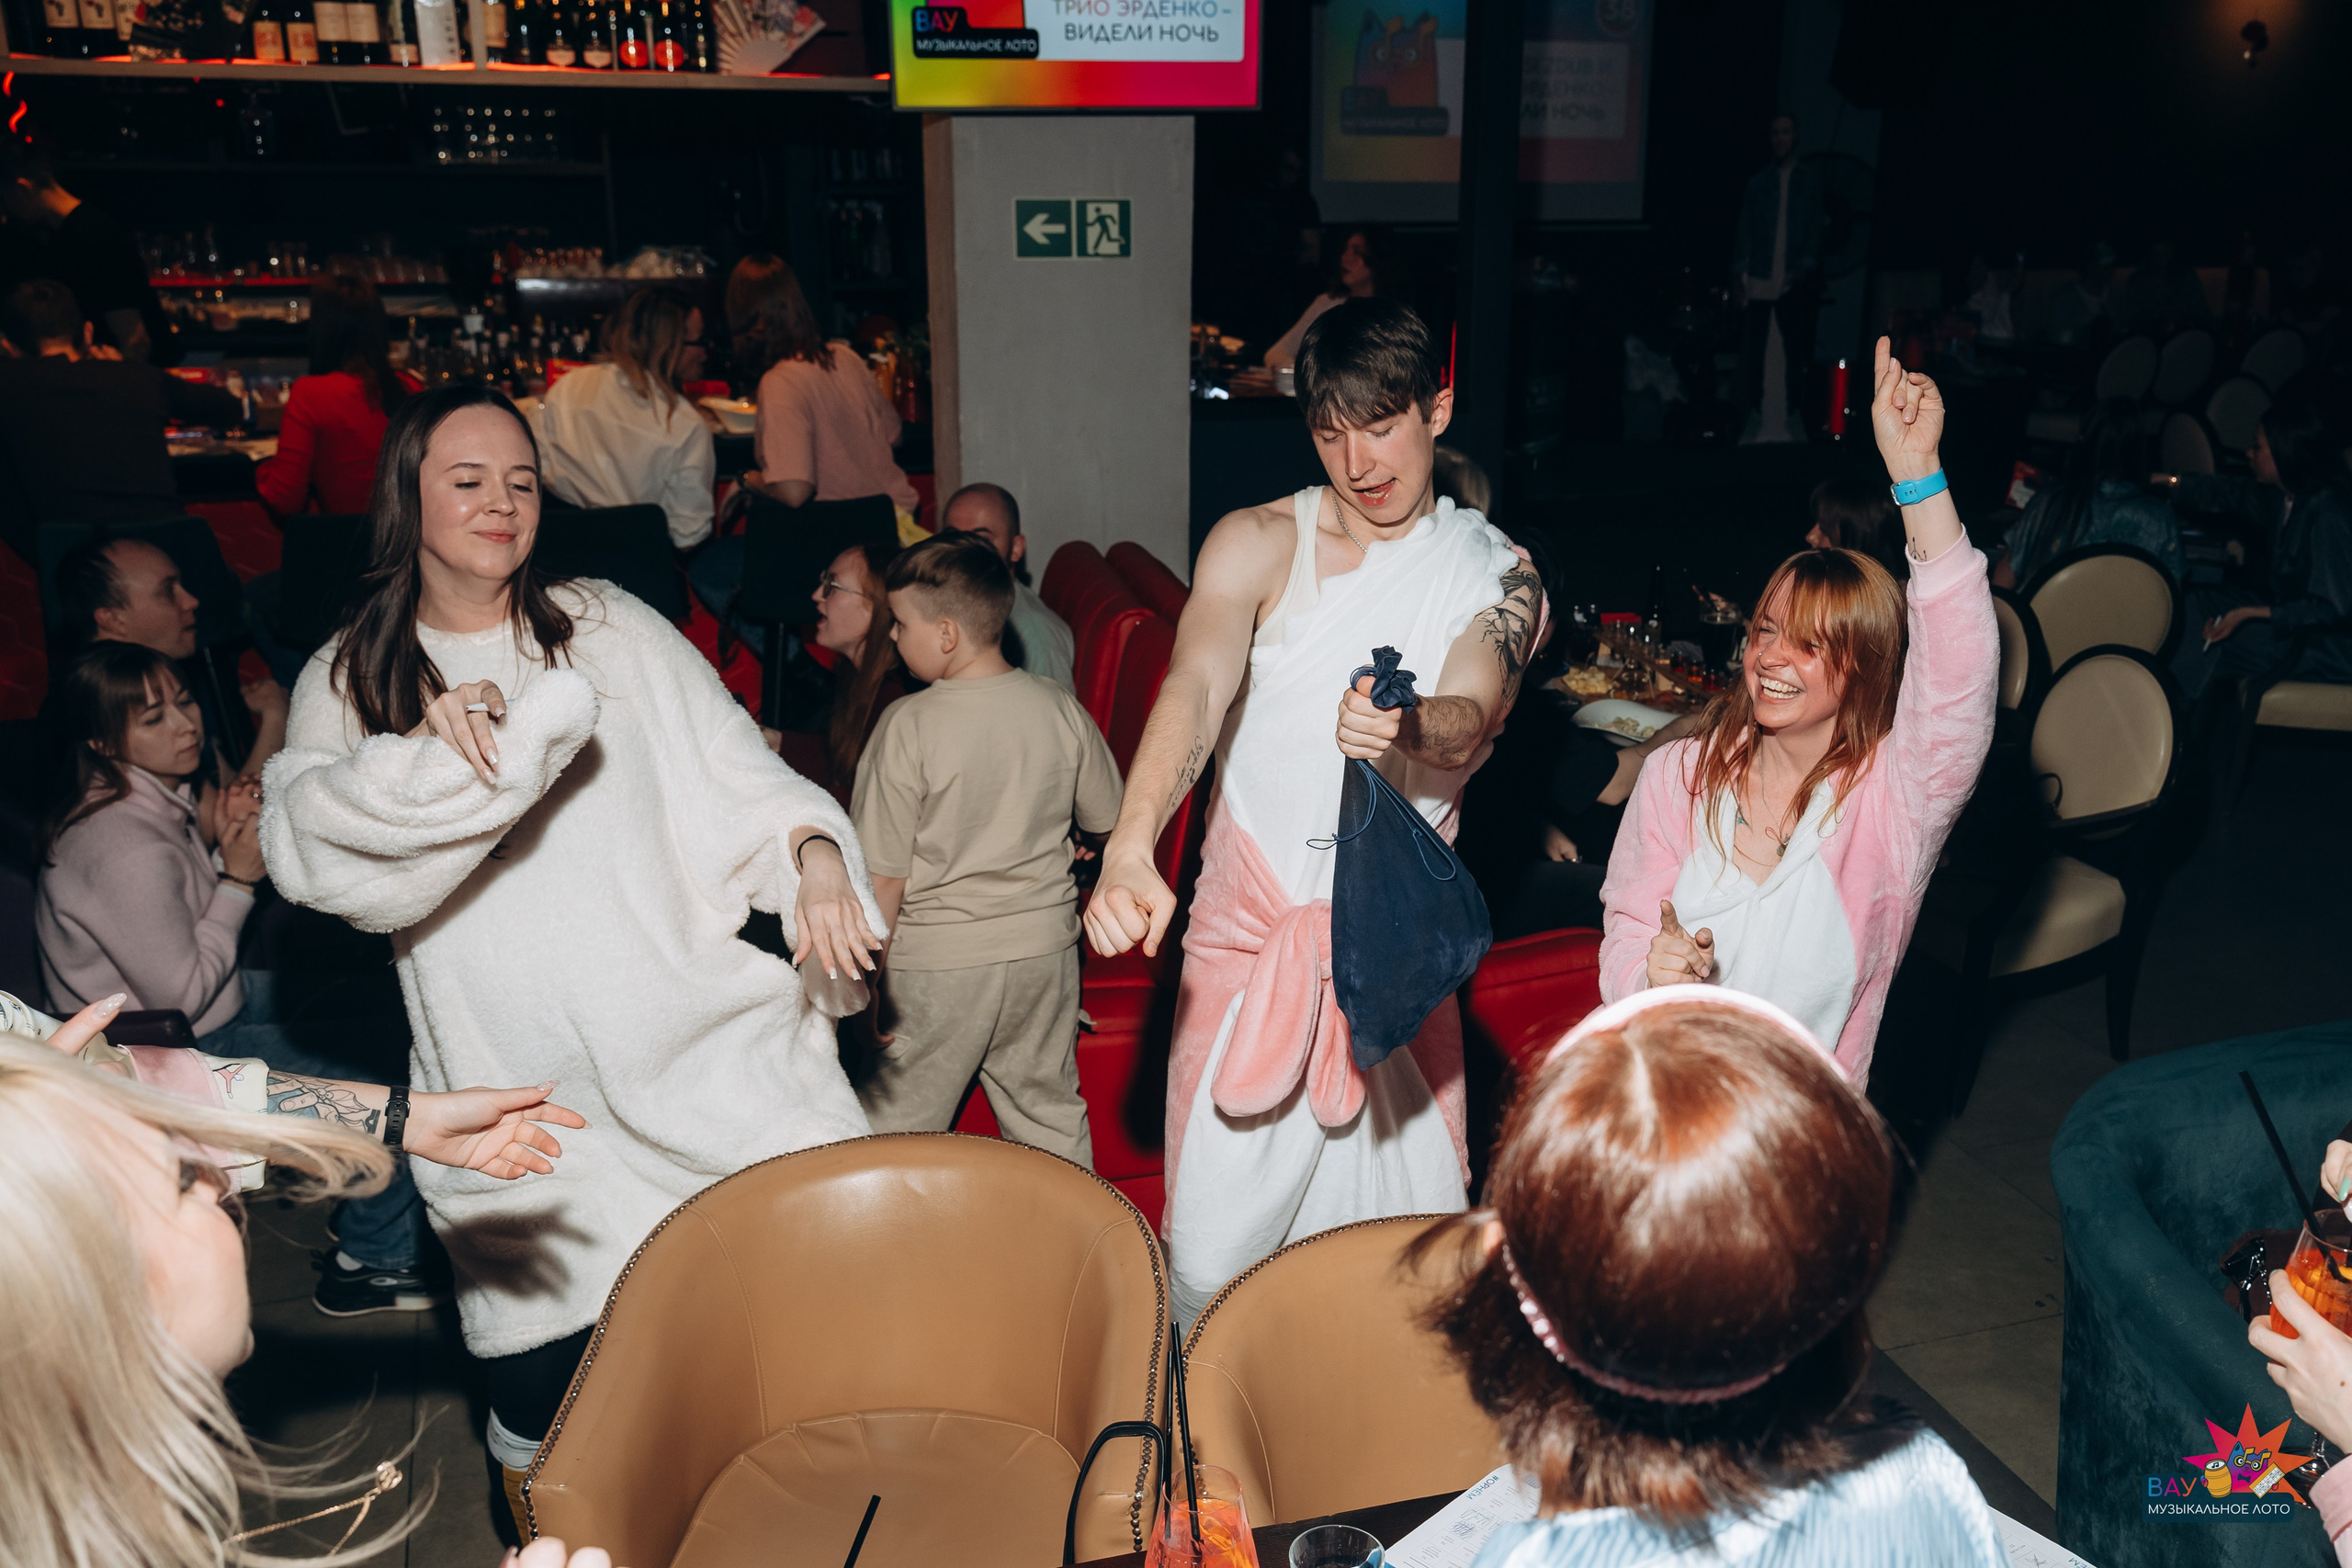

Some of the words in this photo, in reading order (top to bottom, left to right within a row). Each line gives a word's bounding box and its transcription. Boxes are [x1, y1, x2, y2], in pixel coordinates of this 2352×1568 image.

[1054, 0, 1110, 17] ТРИО
[1116, 0, 1218, 19] ЭРДЕНКО
[915, 9, 958, 32] ВАУ
[1064, 23, 1152, 44] ВИДЕЛИ
[1159, 24, 1219, 42] НОЧЬ
[1004, 39, 1037, 51] ЛОТО
